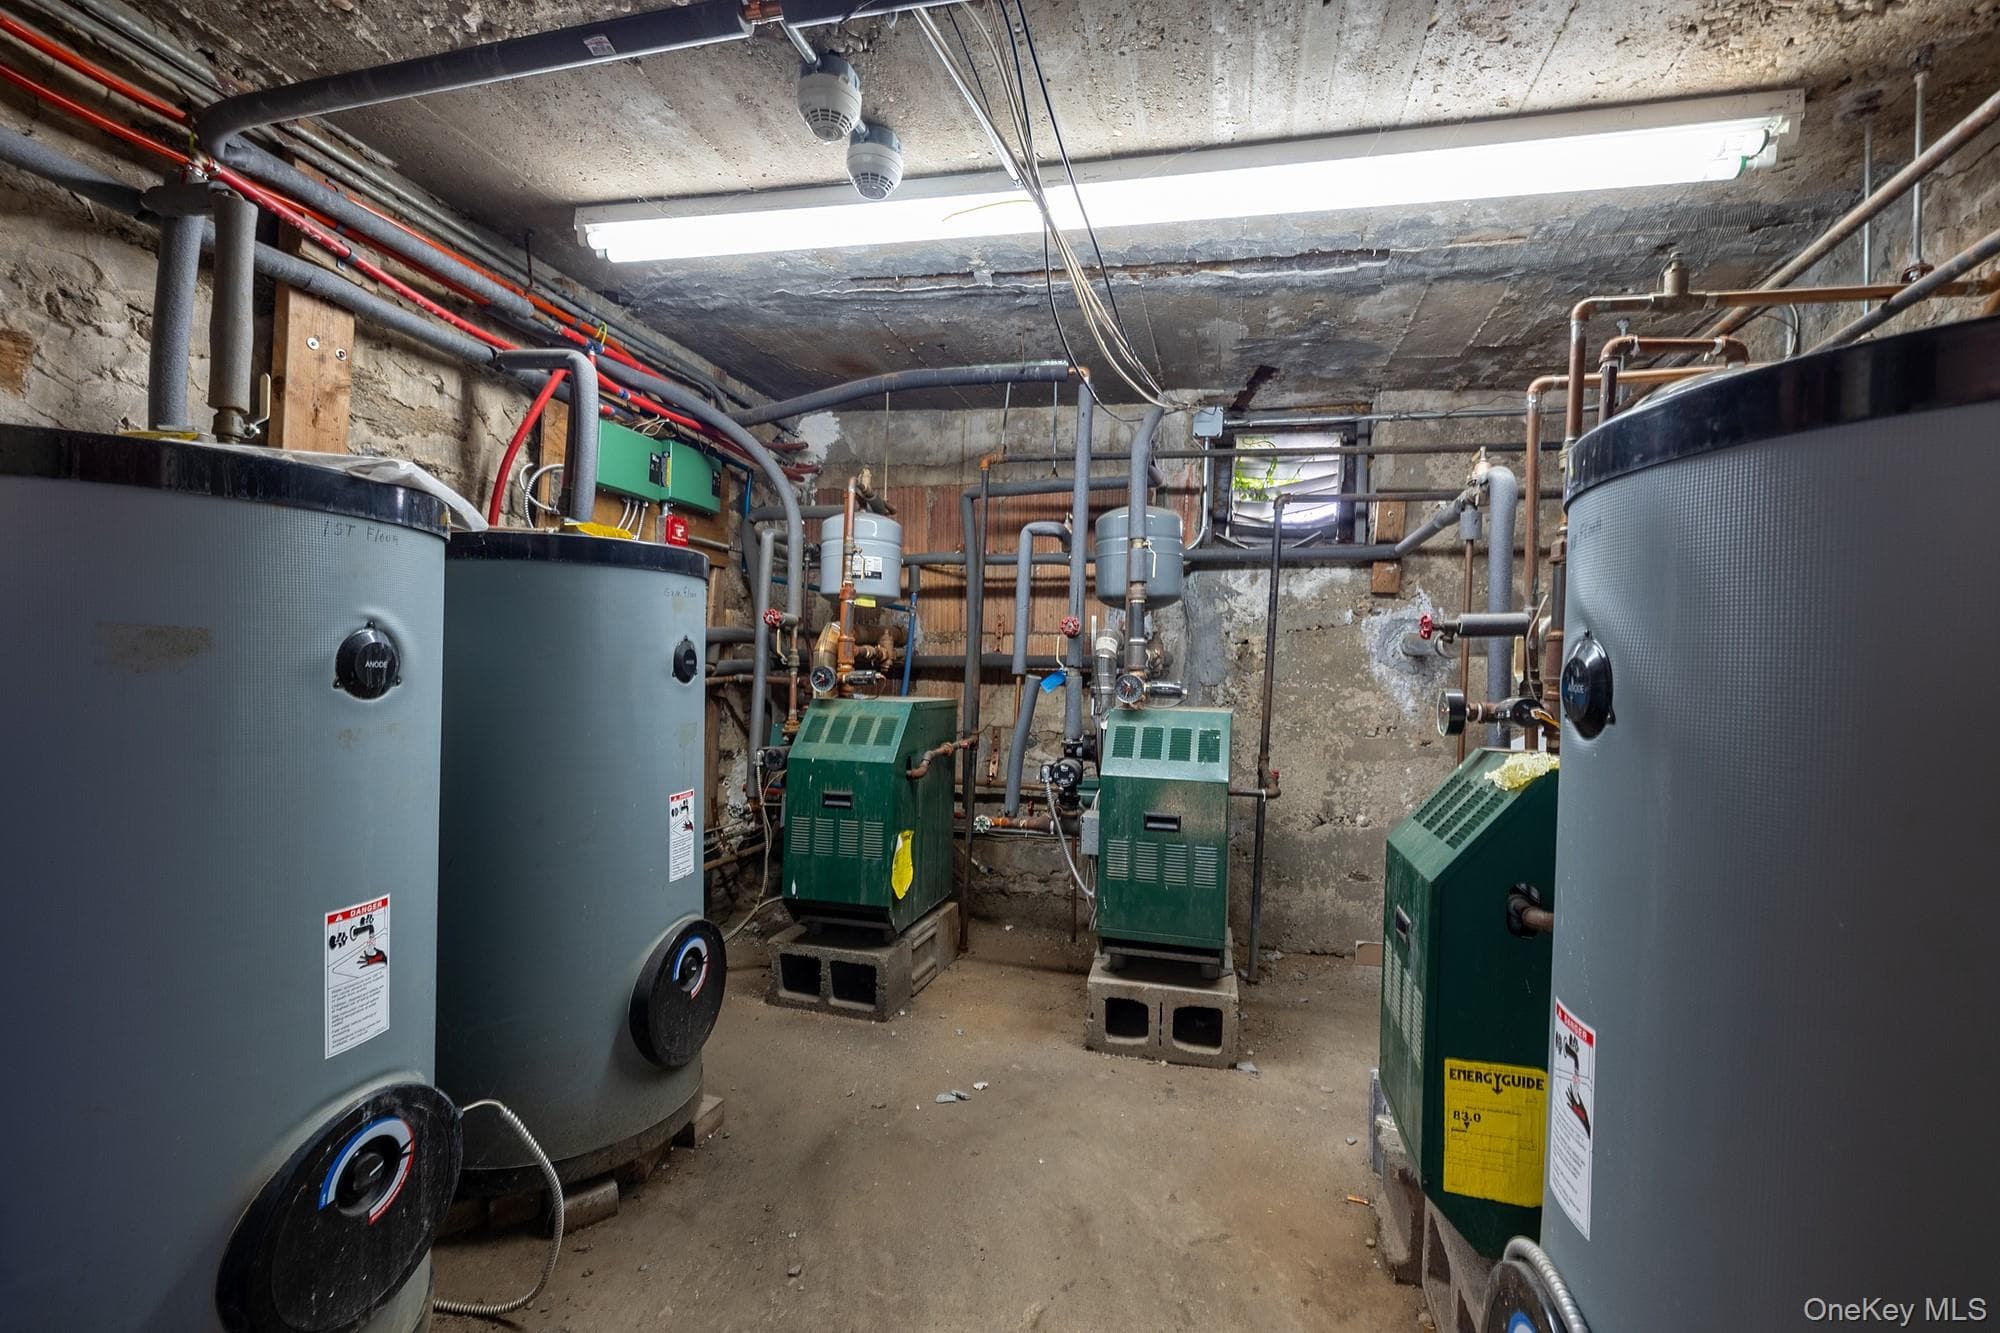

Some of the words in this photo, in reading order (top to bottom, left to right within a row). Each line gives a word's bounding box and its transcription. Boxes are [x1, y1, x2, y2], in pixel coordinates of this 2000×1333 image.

[365, 660, 388, 669] ANODE
[350, 901, 383, 917] DANGER
[1449, 1068, 1545, 1091] ENERGYGUIDE
